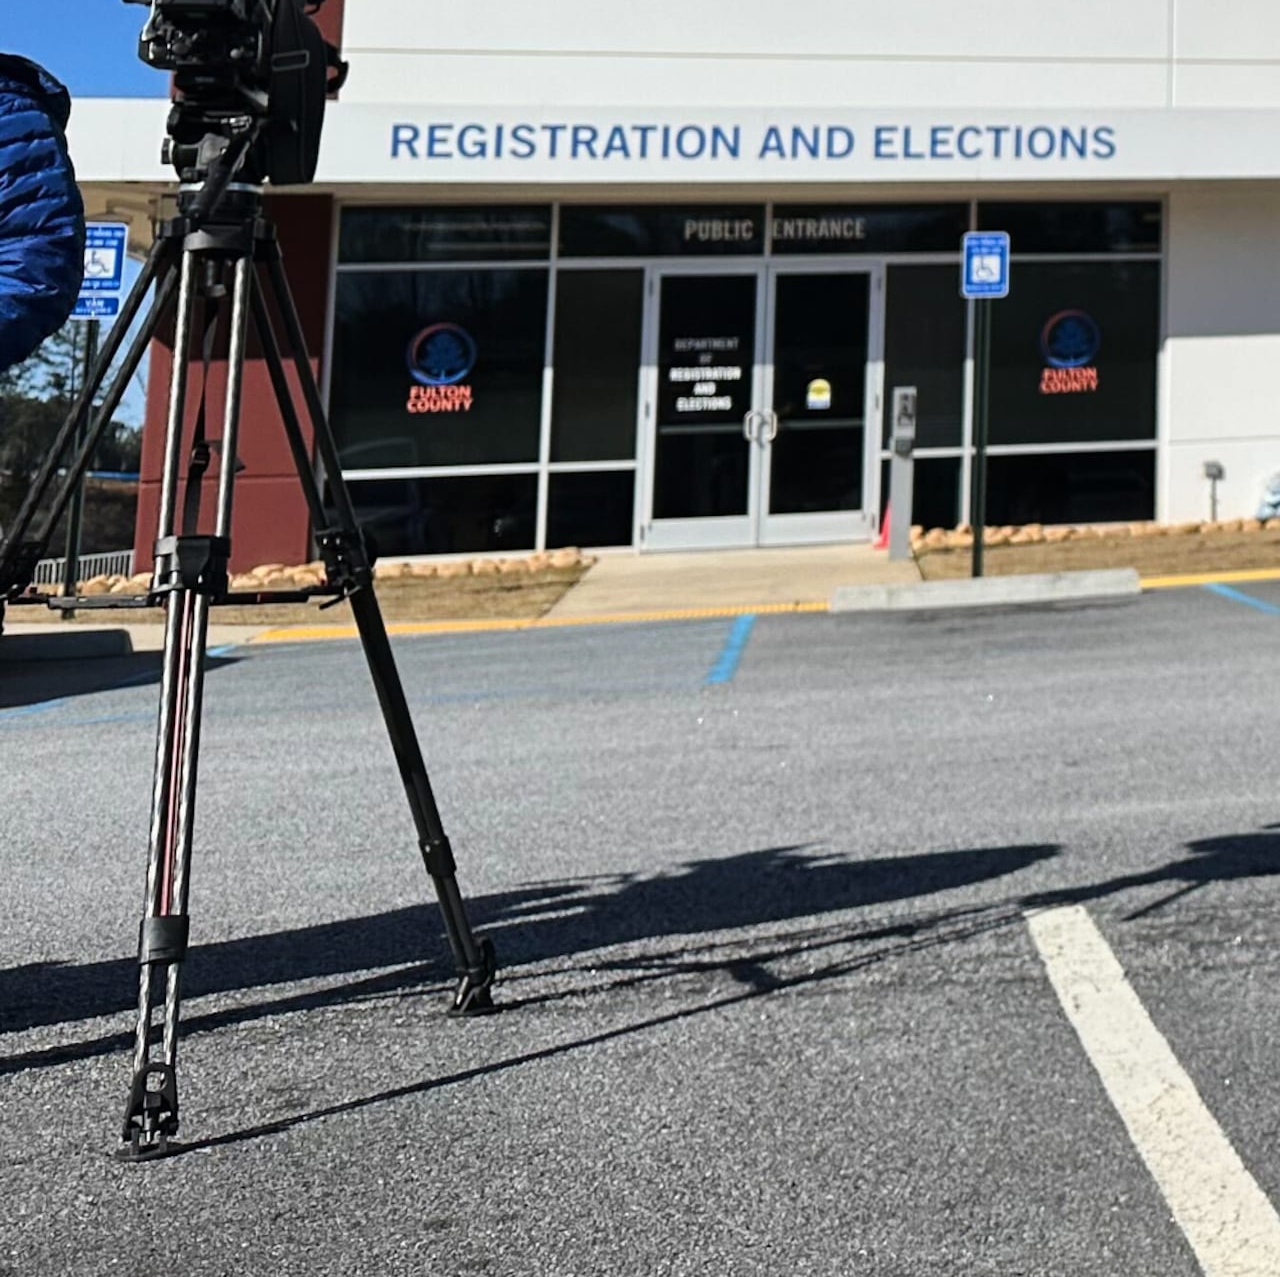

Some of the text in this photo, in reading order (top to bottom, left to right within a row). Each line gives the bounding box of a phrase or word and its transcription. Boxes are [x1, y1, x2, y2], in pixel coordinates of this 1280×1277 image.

[390, 123, 1117, 160] REGISTRATION AND ELECTIONS
[684, 217, 867, 241] PUBLIC ENTRANCE
[669, 366, 742, 381] REGISTRATION
[1042, 366, 1097, 381] FULTON
[410, 385, 472, 398] FULTON
[693, 382, 716, 396] AND
[1039, 378, 1099, 394] COUNTY
[406, 397, 474, 413] COUNTY
[676, 396, 732, 412] ELECTIONS
